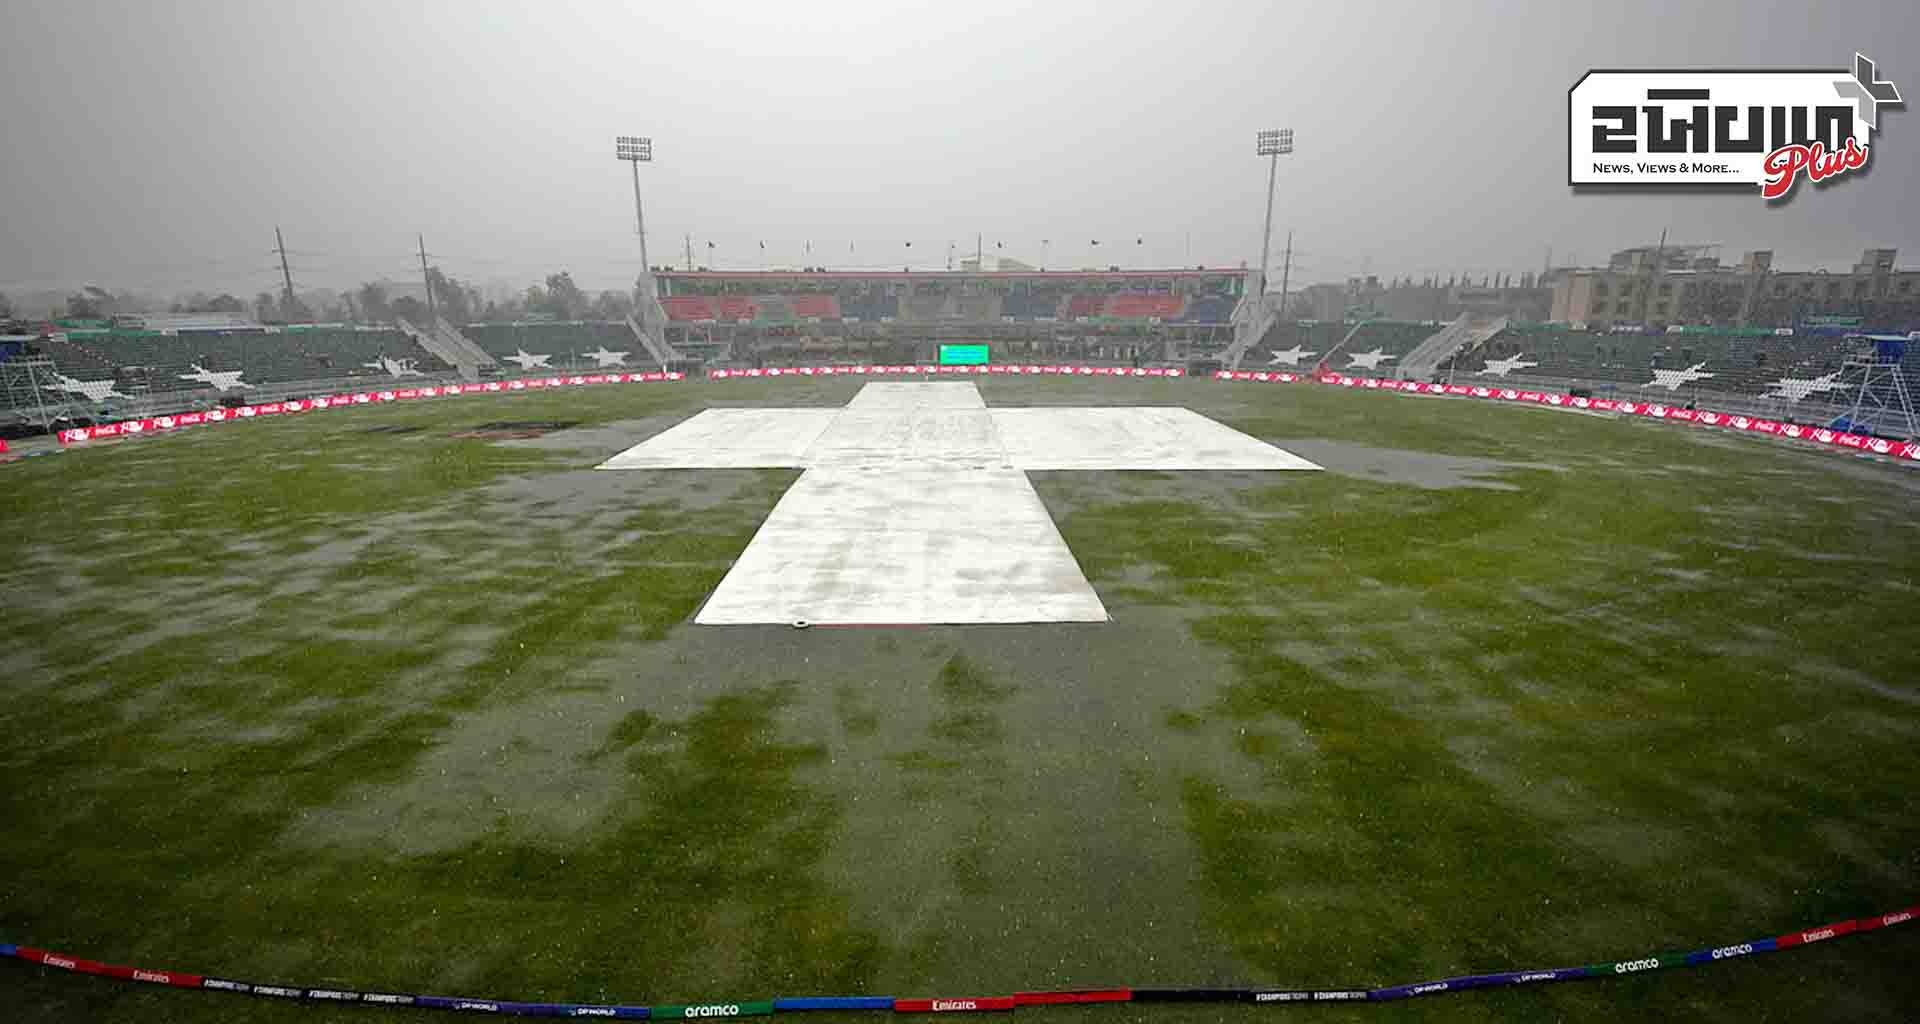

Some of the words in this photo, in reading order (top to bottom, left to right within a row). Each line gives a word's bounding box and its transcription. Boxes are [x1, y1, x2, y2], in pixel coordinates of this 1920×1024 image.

[1712, 943, 1753, 959] aramco
[1615, 957, 1659, 973] aramco
[685, 1004, 739, 1018] aramco
[932, 999, 976, 1011] Emirates
